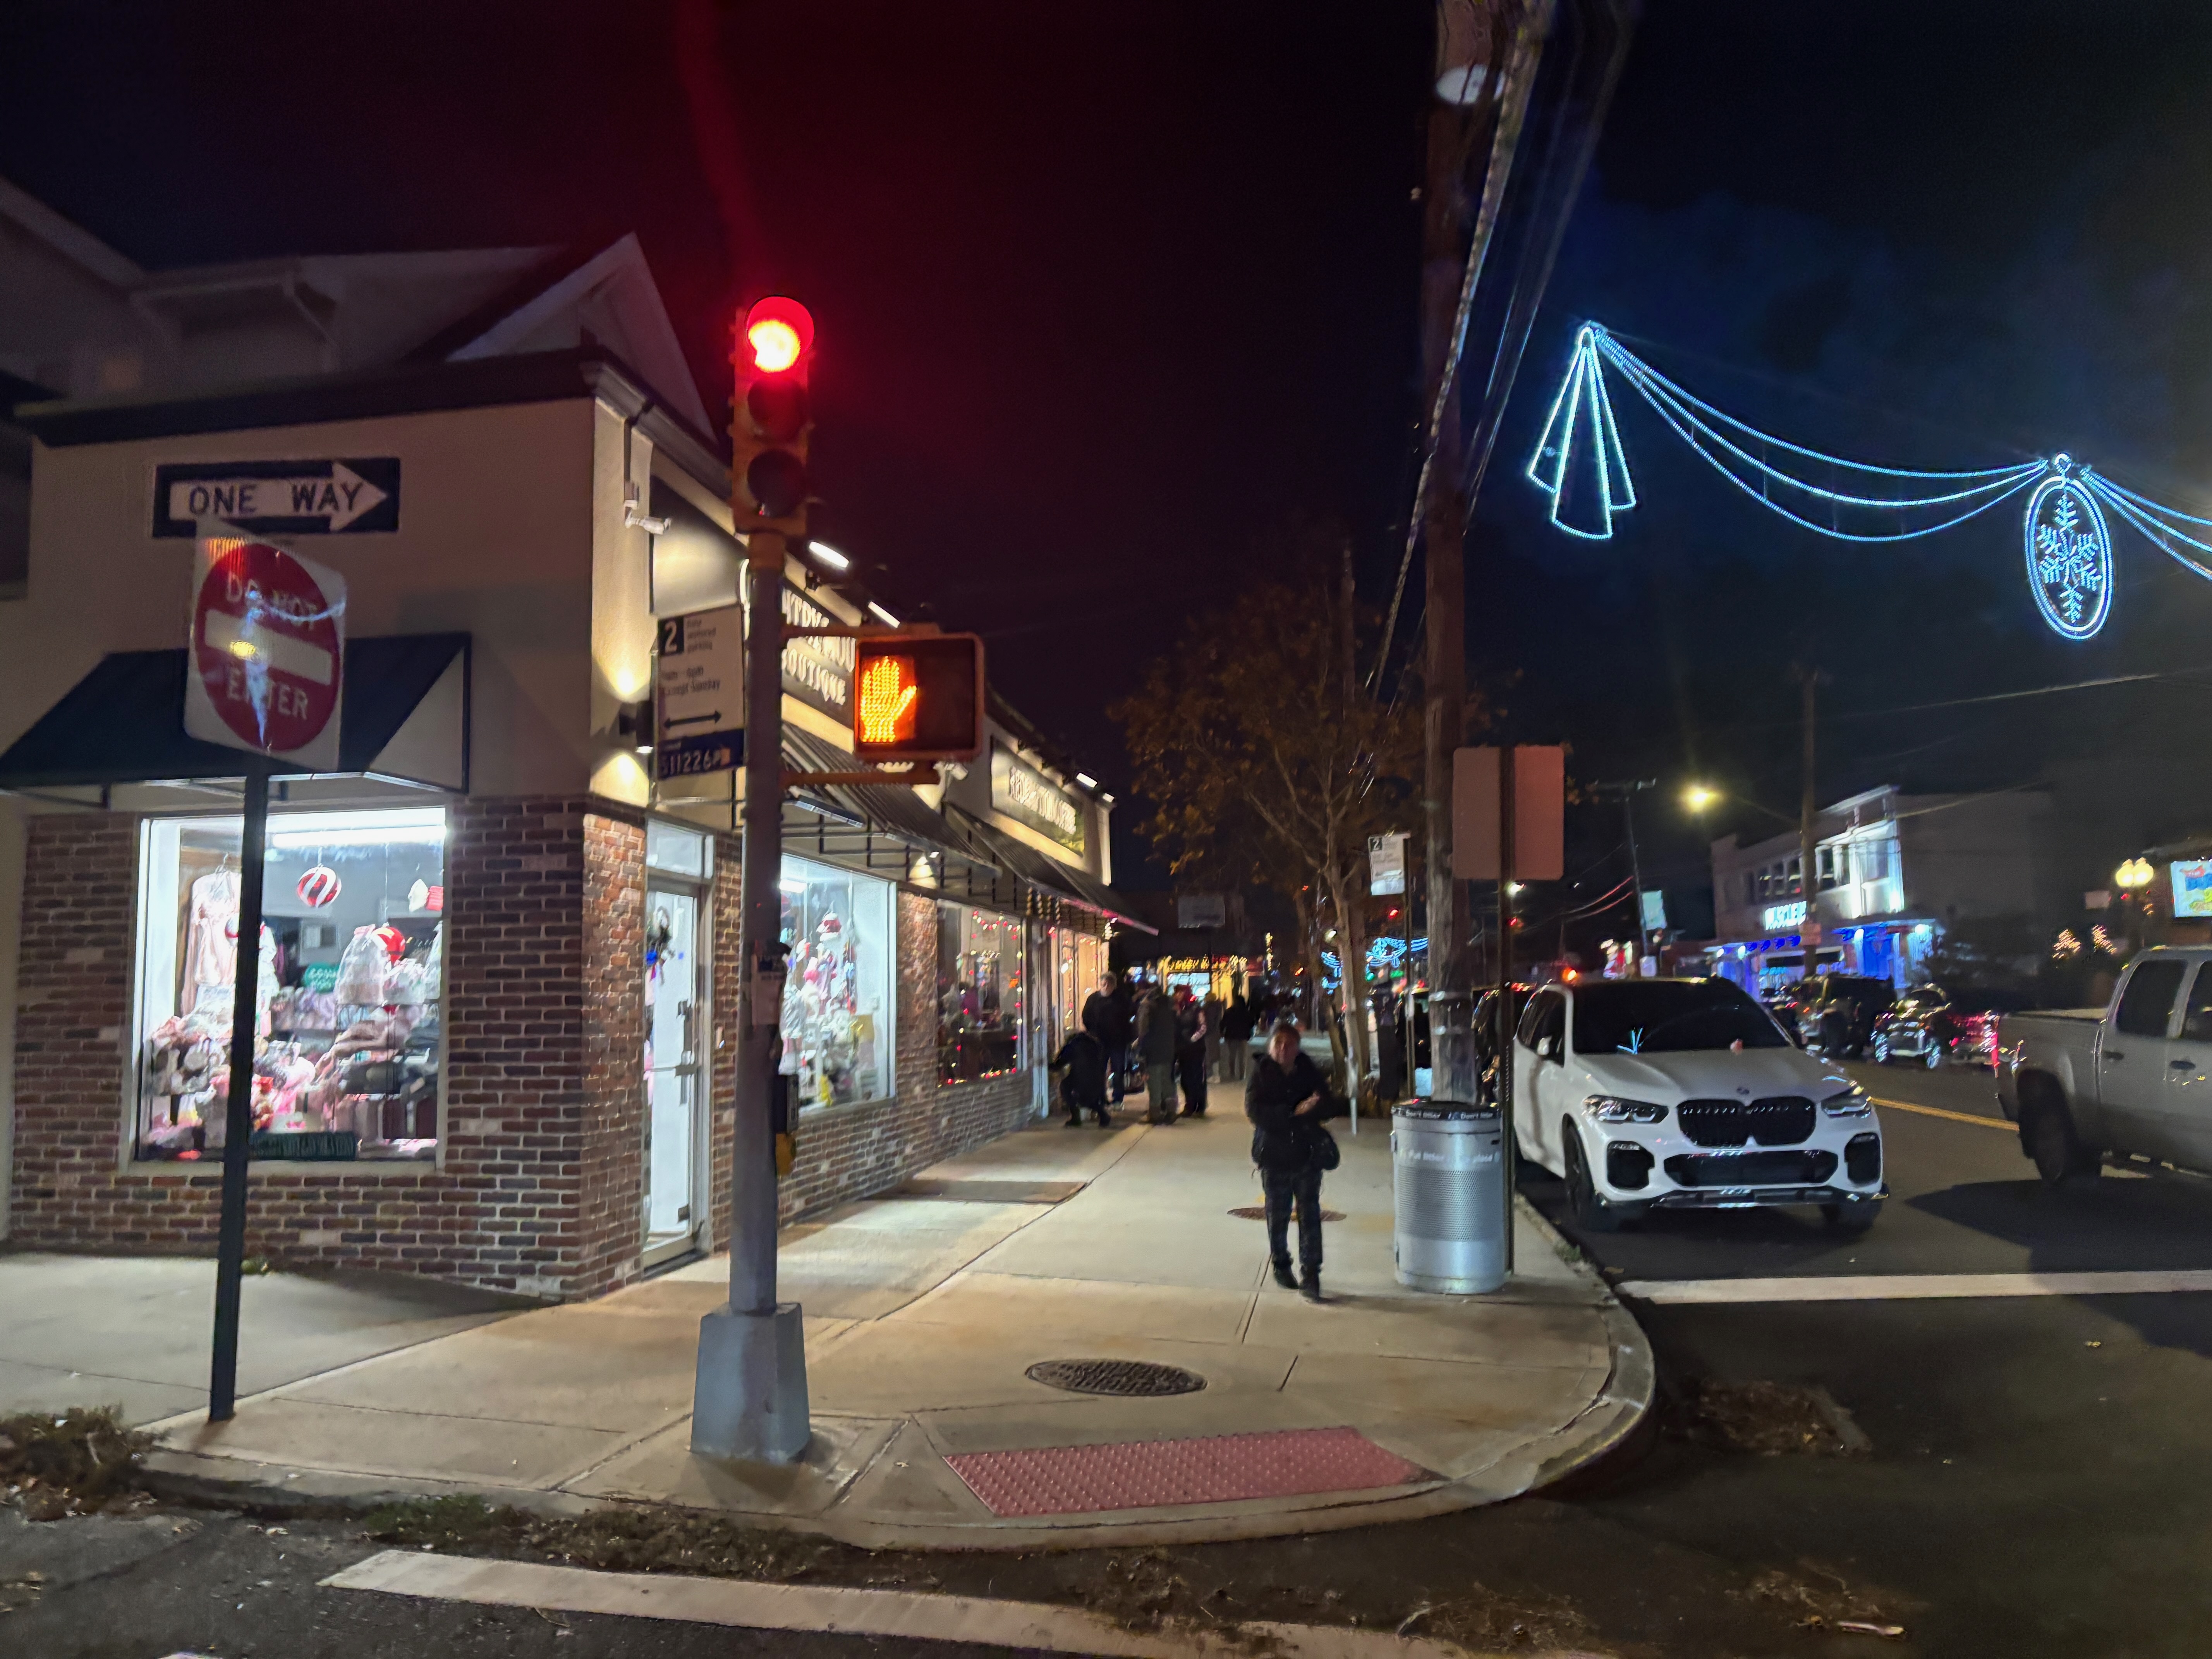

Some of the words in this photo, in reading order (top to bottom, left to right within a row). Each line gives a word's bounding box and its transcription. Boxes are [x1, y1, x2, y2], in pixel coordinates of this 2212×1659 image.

[189, 483, 257, 515] ONE
[291, 481, 363, 513] WAY
[664, 621, 677, 653] 2
[1372, 839, 1379, 851] 2
